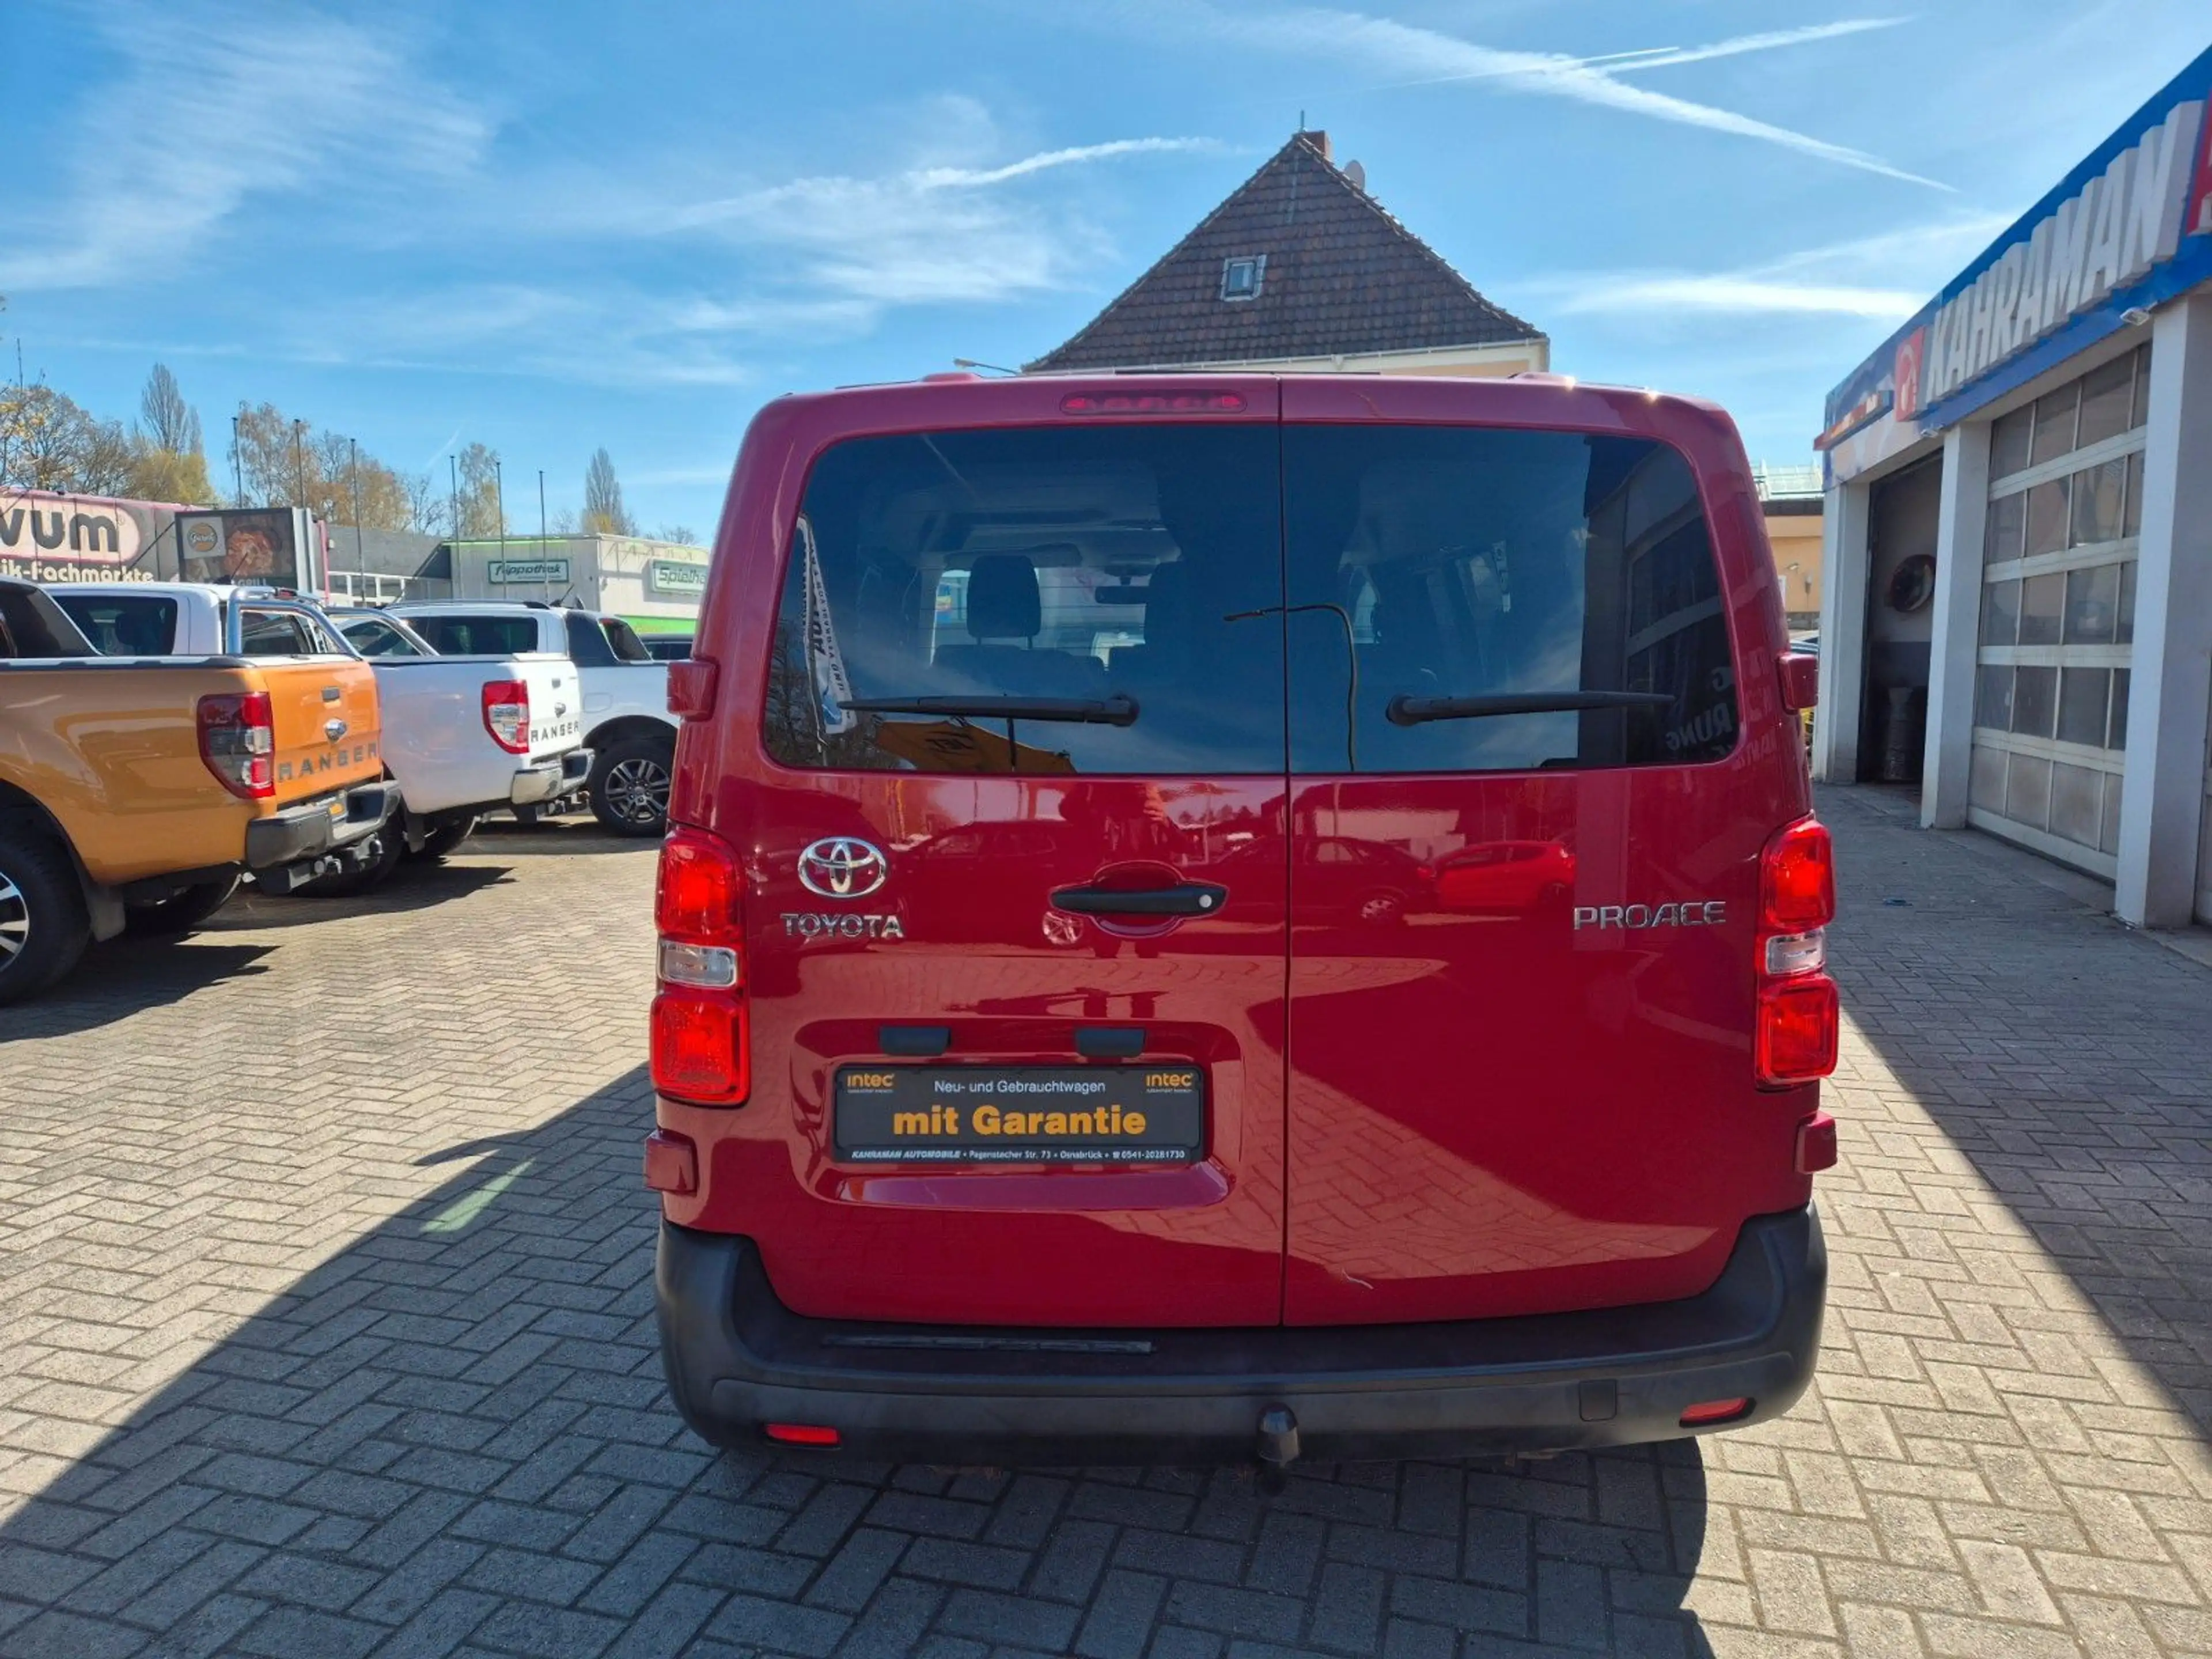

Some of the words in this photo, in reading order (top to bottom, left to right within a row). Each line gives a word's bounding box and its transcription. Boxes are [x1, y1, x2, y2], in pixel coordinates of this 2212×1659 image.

[1925, 100, 2204, 402] KAHRAMAN
[531, 720, 579, 743] RANGER
[278, 742, 377, 783] RANGER
[780, 913, 904, 938] TOYOTA
[1574, 901, 1726, 930] PROACE
[934, 1080, 966, 1093] Neu-
[969, 1080, 993, 1093] und
[997, 1080, 1106, 1094] Gebrauchtwagen
[894, 1104, 959, 1135] mit
[972, 1104, 1146, 1135] Garantie
[903, 1150, 961, 1158] AUTOMOBILE
[1059, 1150, 1103, 1159] Osnabrück
